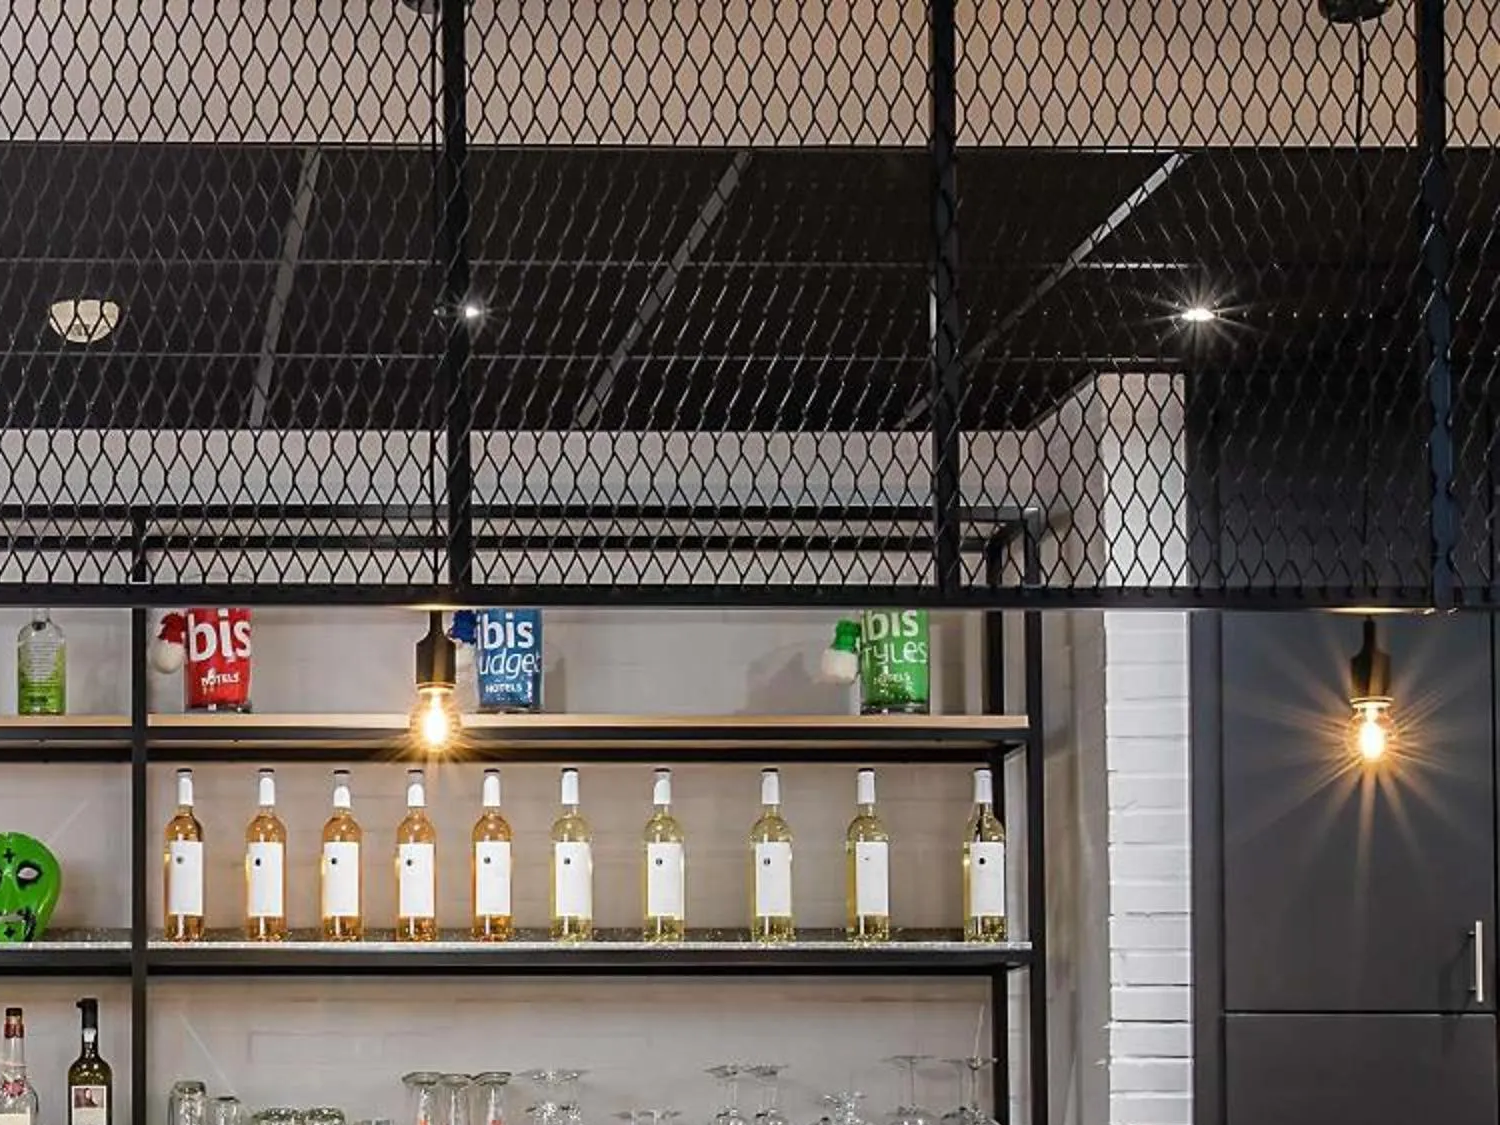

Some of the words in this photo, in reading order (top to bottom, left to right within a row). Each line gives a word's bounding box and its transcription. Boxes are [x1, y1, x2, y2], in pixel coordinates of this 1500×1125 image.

[186, 607, 251, 662] bis
[479, 647, 541, 680] udget
[485, 682, 523, 693] HOTELS
